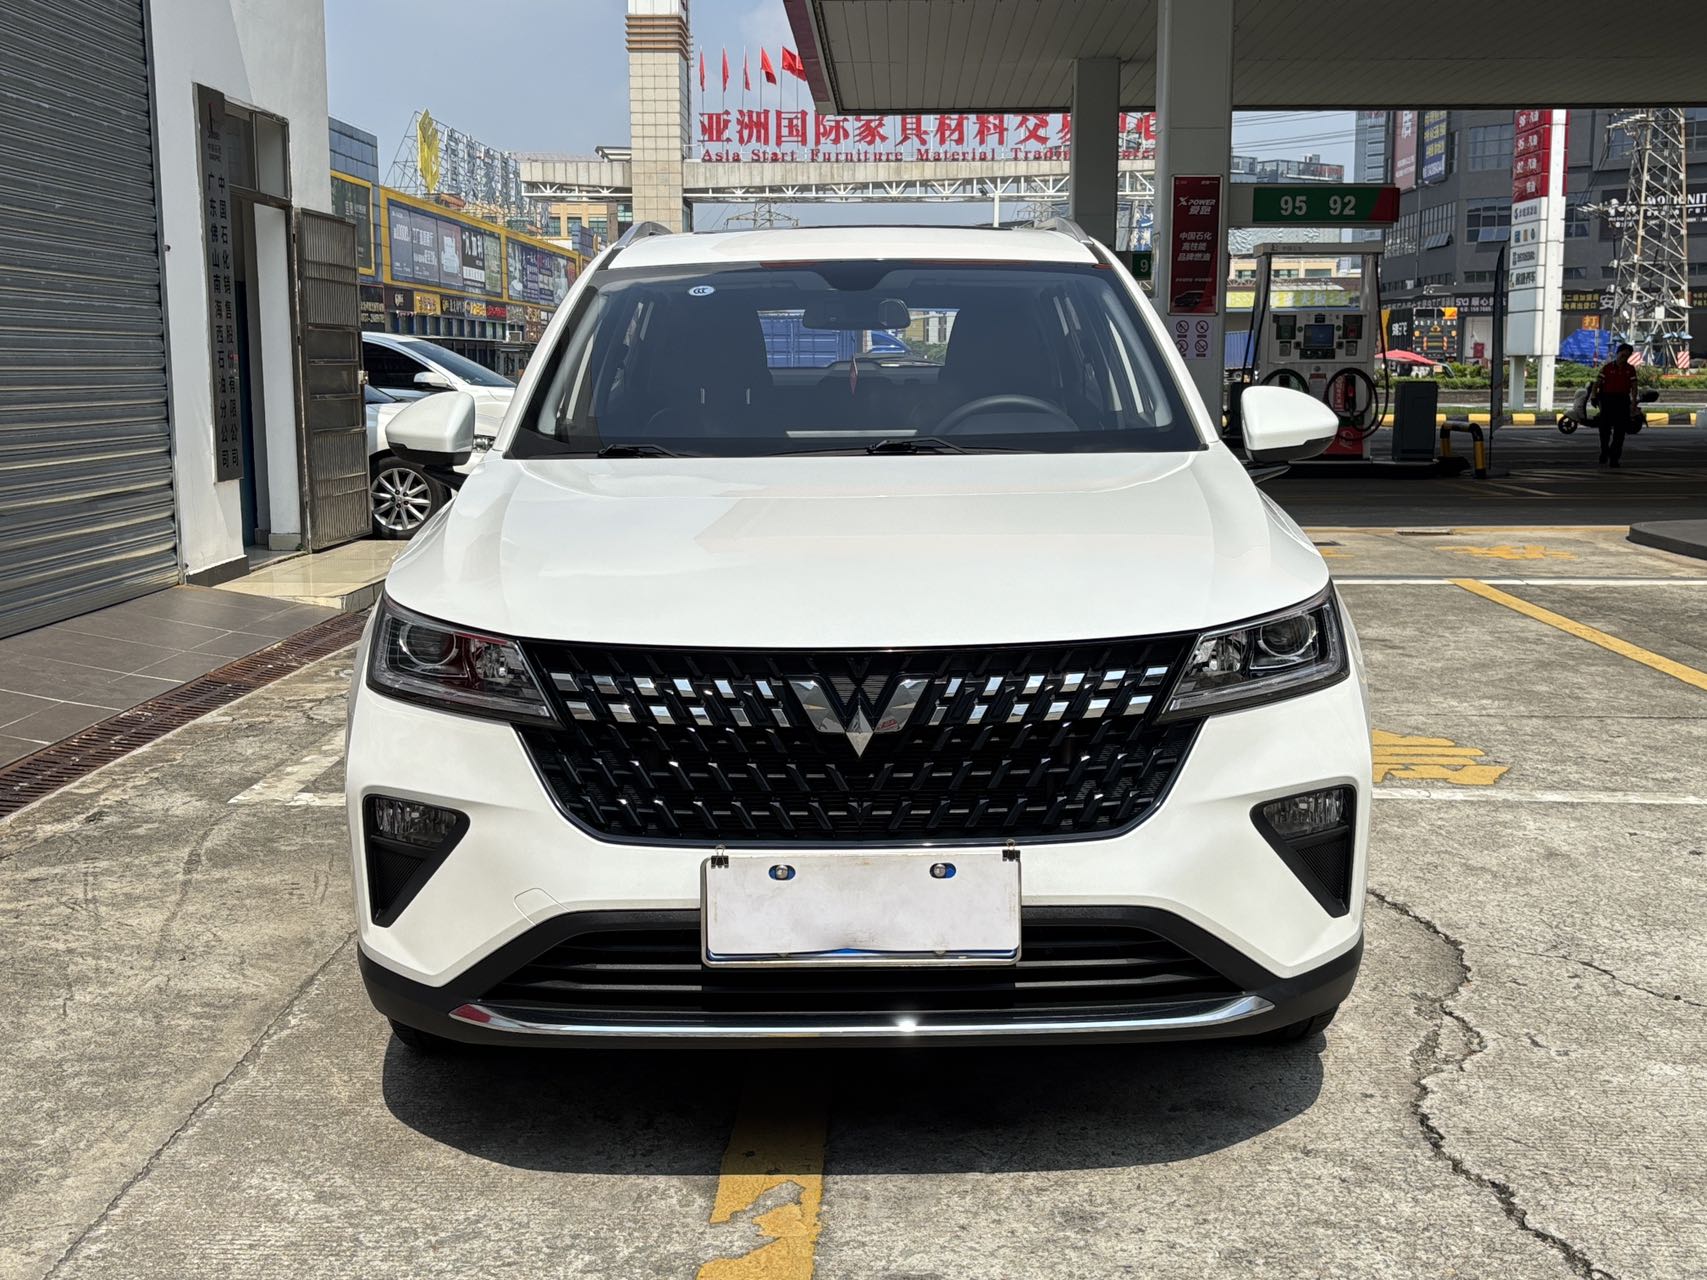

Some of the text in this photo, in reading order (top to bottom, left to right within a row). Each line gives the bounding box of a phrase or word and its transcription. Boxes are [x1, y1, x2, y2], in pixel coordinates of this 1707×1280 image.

[702, 149, 741, 162] Asia
[751, 149, 797, 162] Start
[810, 148, 903, 162] Furniture
[916, 148, 996, 161] Material
[1280, 196, 1356, 216] 95 92
[1179, 232, 1212, 241] 中国石化
[1182, 242, 1207, 251] 高性能
